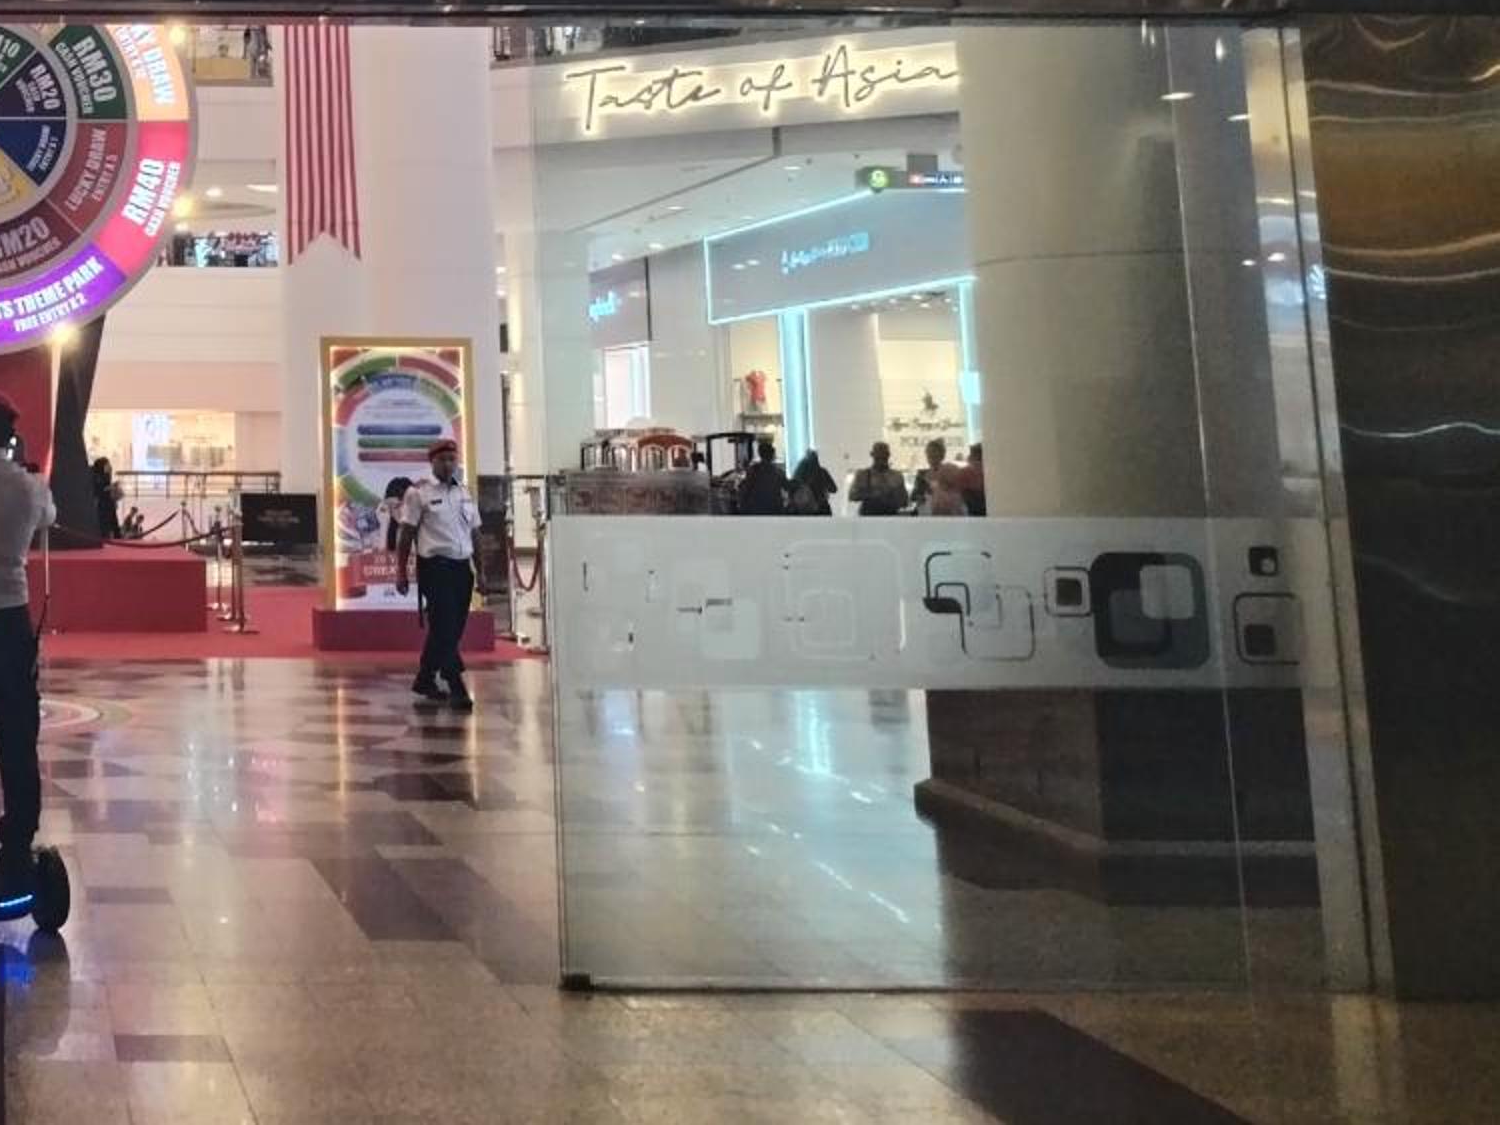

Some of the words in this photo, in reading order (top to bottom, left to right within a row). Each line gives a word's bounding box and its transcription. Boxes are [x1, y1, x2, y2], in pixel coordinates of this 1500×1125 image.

[30, 63, 61, 110] RM20
[55, 41, 78, 69] CASH
[71, 69, 94, 114] VOUCHER
[73, 36, 117, 102] RM30
[566, 65, 720, 131] Taste
[739, 64, 793, 111] of
[811, 44, 958, 108] Asia
[64, 170, 95, 211] LUCKY
[85, 128, 107, 170] DRAW
[121, 158, 165, 225] RM40
[12, 281, 67, 316] THEME
[60, 256, 105, 293] PARK
[13, 314, 39, 333] FREE
